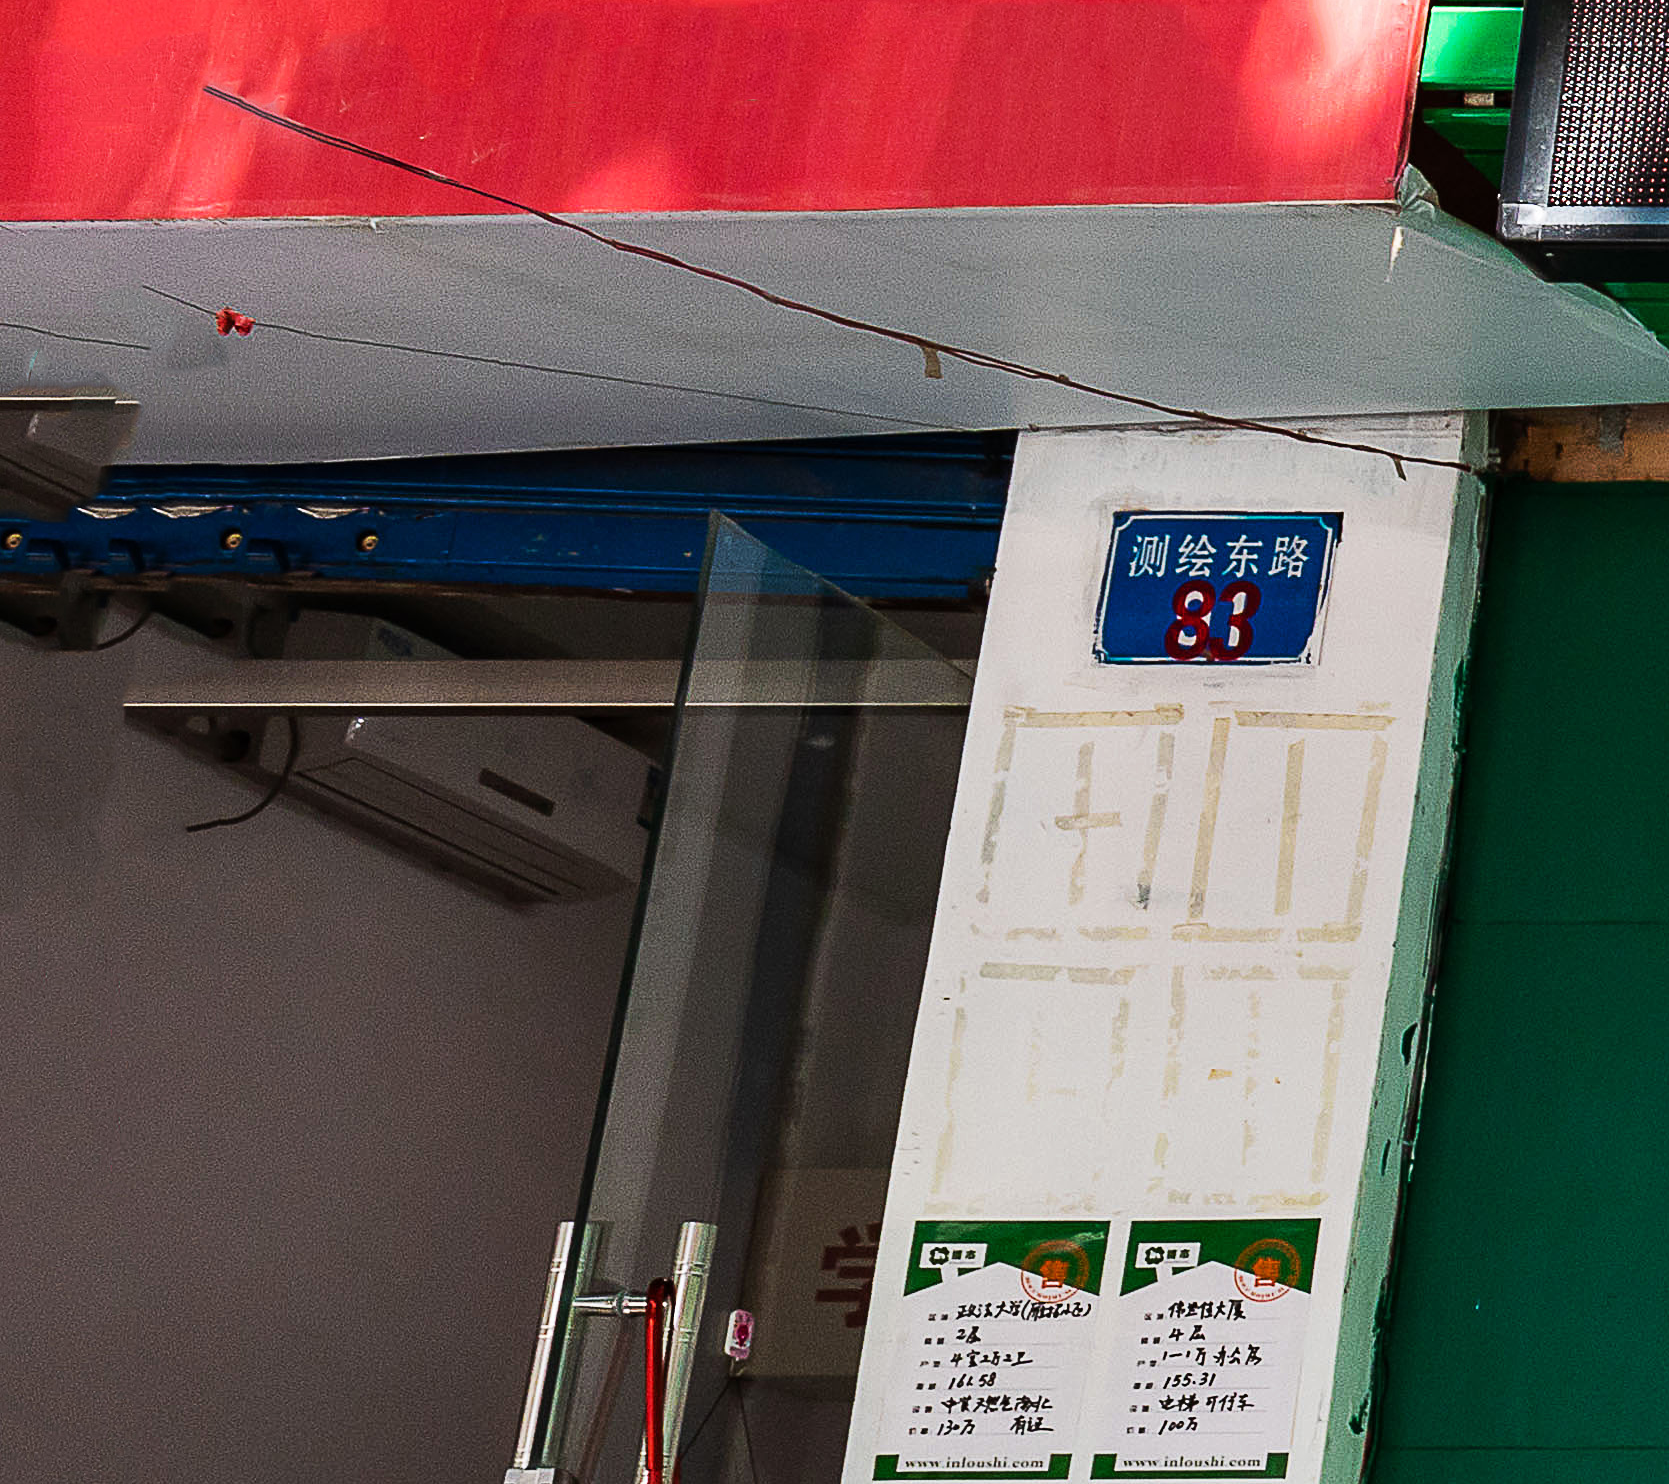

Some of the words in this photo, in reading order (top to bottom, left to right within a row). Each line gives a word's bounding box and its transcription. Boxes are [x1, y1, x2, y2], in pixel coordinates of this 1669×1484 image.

[1128, 534, 1310, 578] 测绘东路
[1164, 579, 1262, 661] 83
[1162, 1372, 1217, 1390] 155.31
[905, 1456, 1044, 1469] www.inloushi.com
[1123, 1455, 1261, 1468] www.inloushi.com
